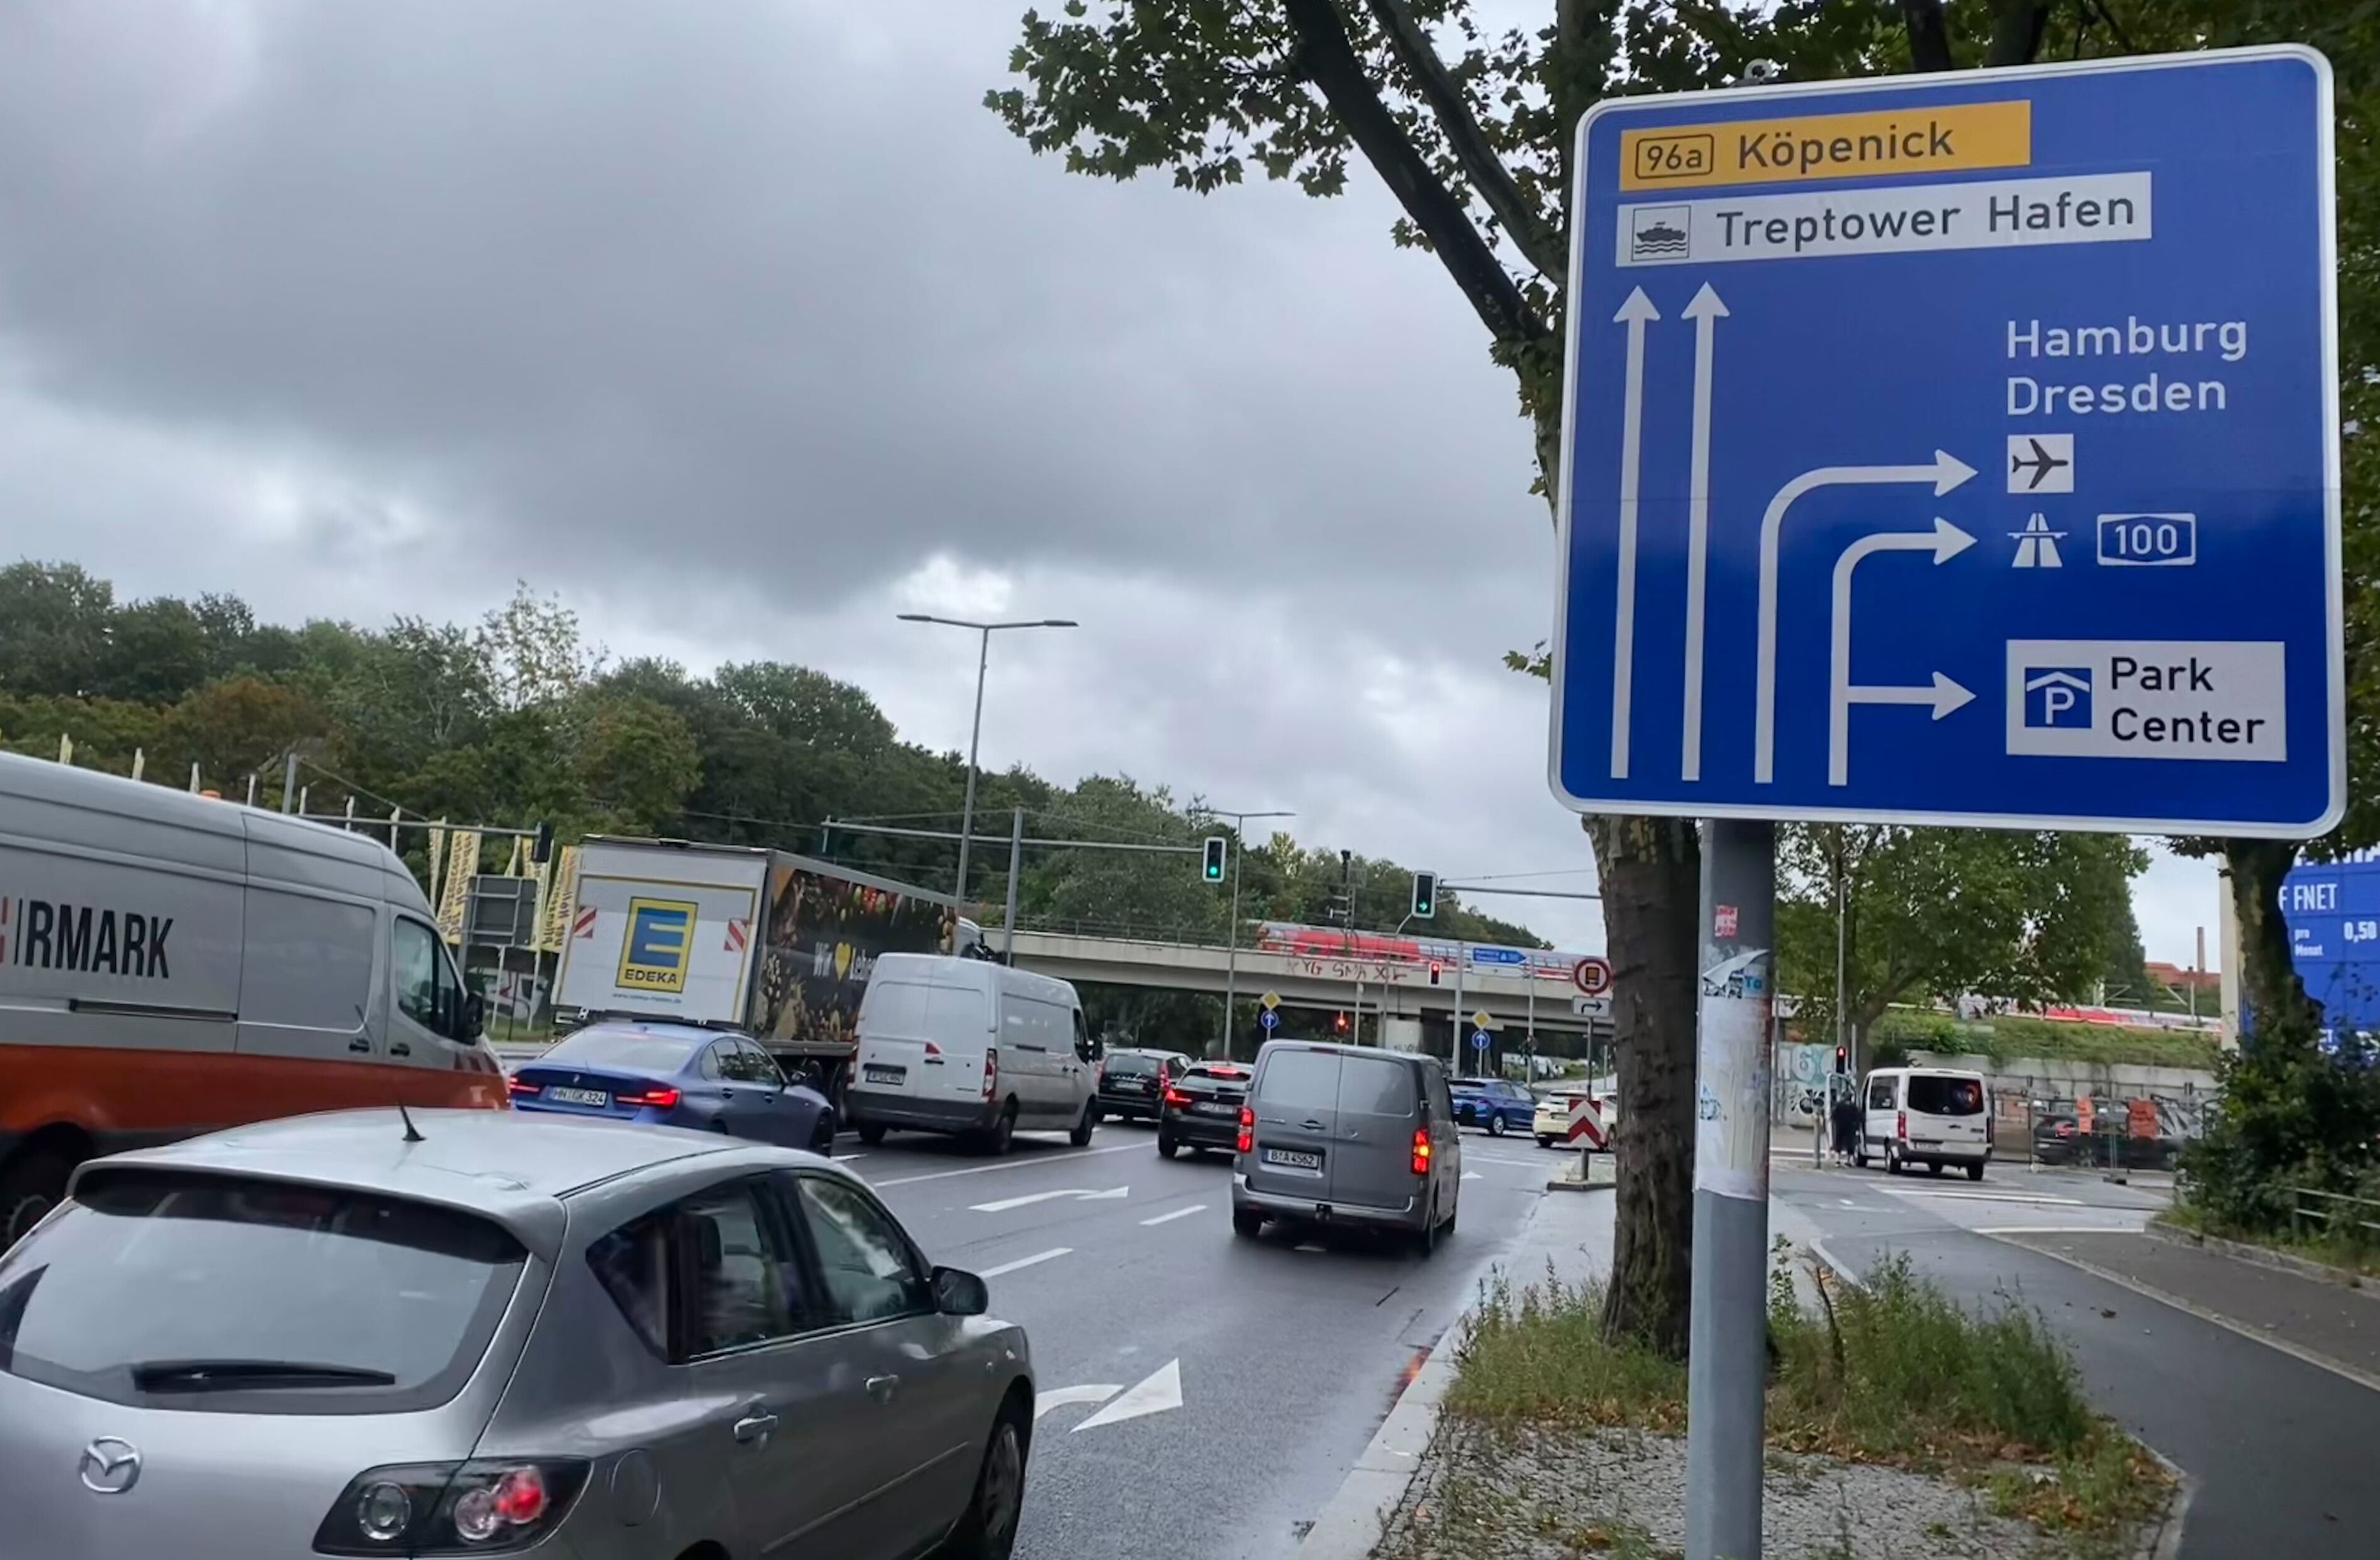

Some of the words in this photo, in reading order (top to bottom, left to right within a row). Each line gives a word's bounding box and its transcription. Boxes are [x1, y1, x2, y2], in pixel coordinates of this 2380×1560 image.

[1647, 143, 1702, 171] 96a
[1739, 120, 1954, 175] Köpenick
[1716, 206, 1961, 252] Treptower
[1989, 191, 2134, 232] Hafen
[2008, 316, 2247, 361] Hamburg
[2008, 372, 2226, 415] Dresden
[2115, 524, 2178, 555] 100
[2111, 656, 2214, 691] Park
[2111, 707, 2265, 744] Center
[625, 968, 677, 983] EDEKA
